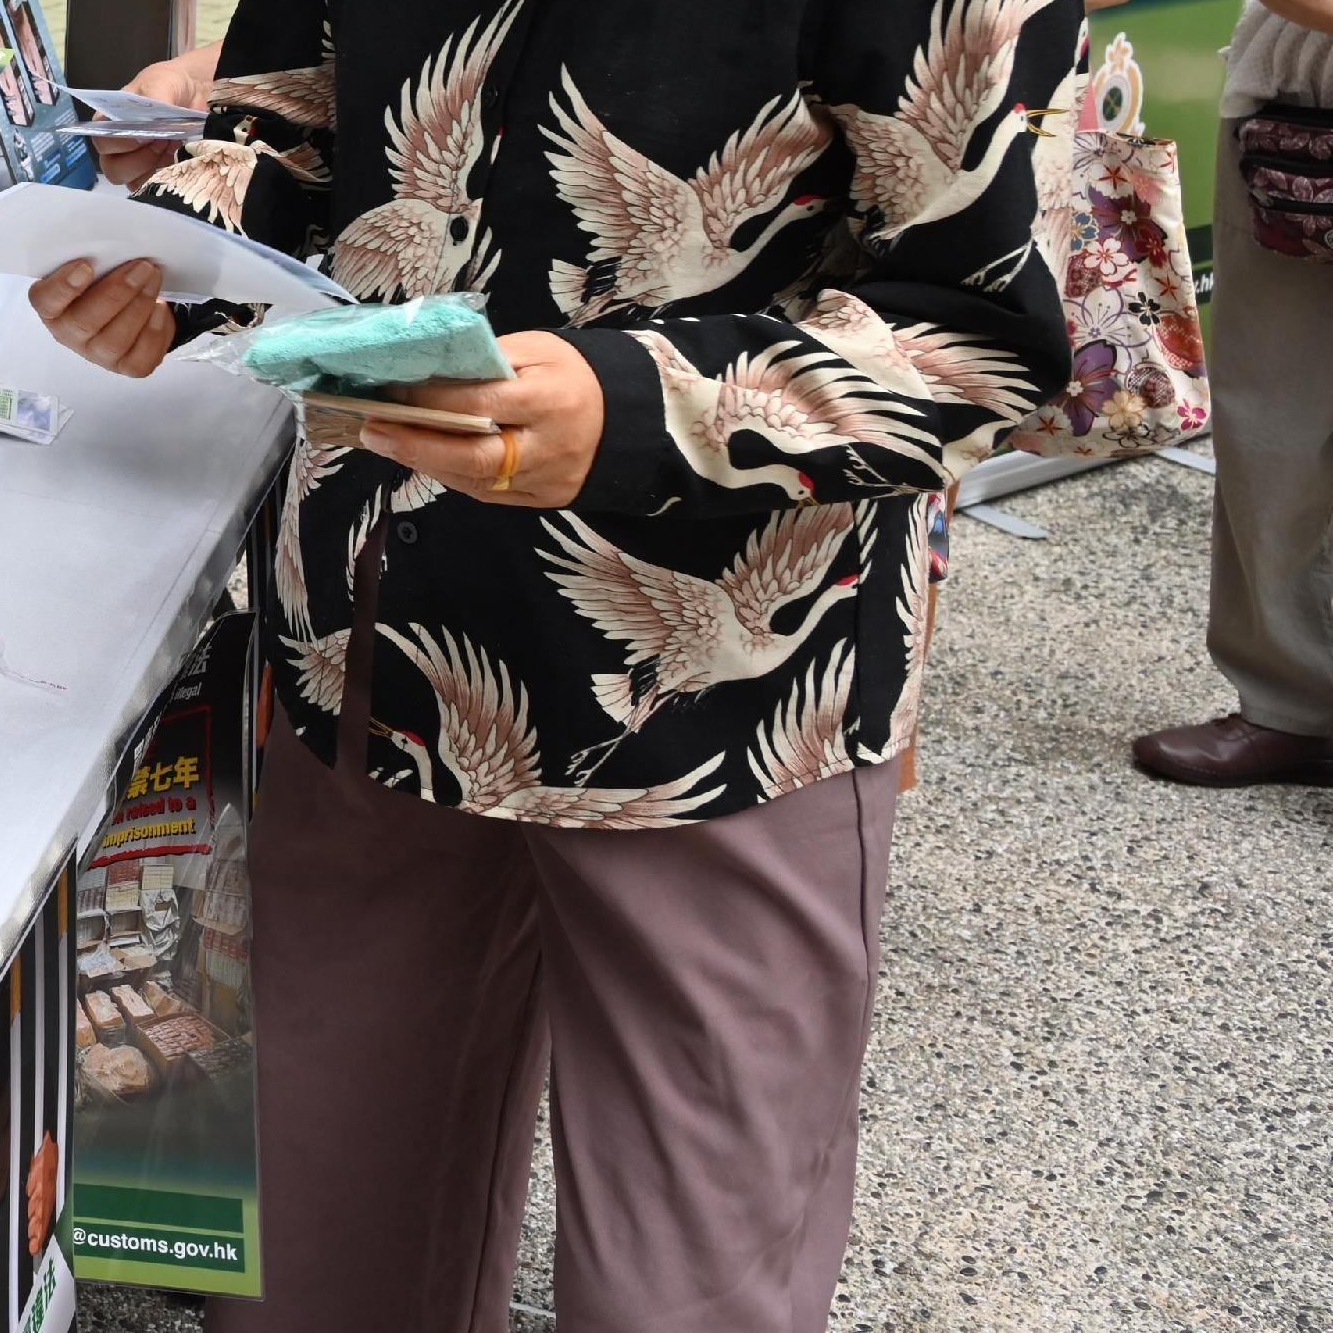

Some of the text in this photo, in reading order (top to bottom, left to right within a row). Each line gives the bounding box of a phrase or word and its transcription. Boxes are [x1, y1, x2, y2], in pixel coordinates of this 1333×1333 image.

[167, 795, 182, 813] to
[185, 796, 197, 812] a
[102, 818, 197, 848] imprisonment
[73, 1227, 238, 1261] @customs.gov.hk
